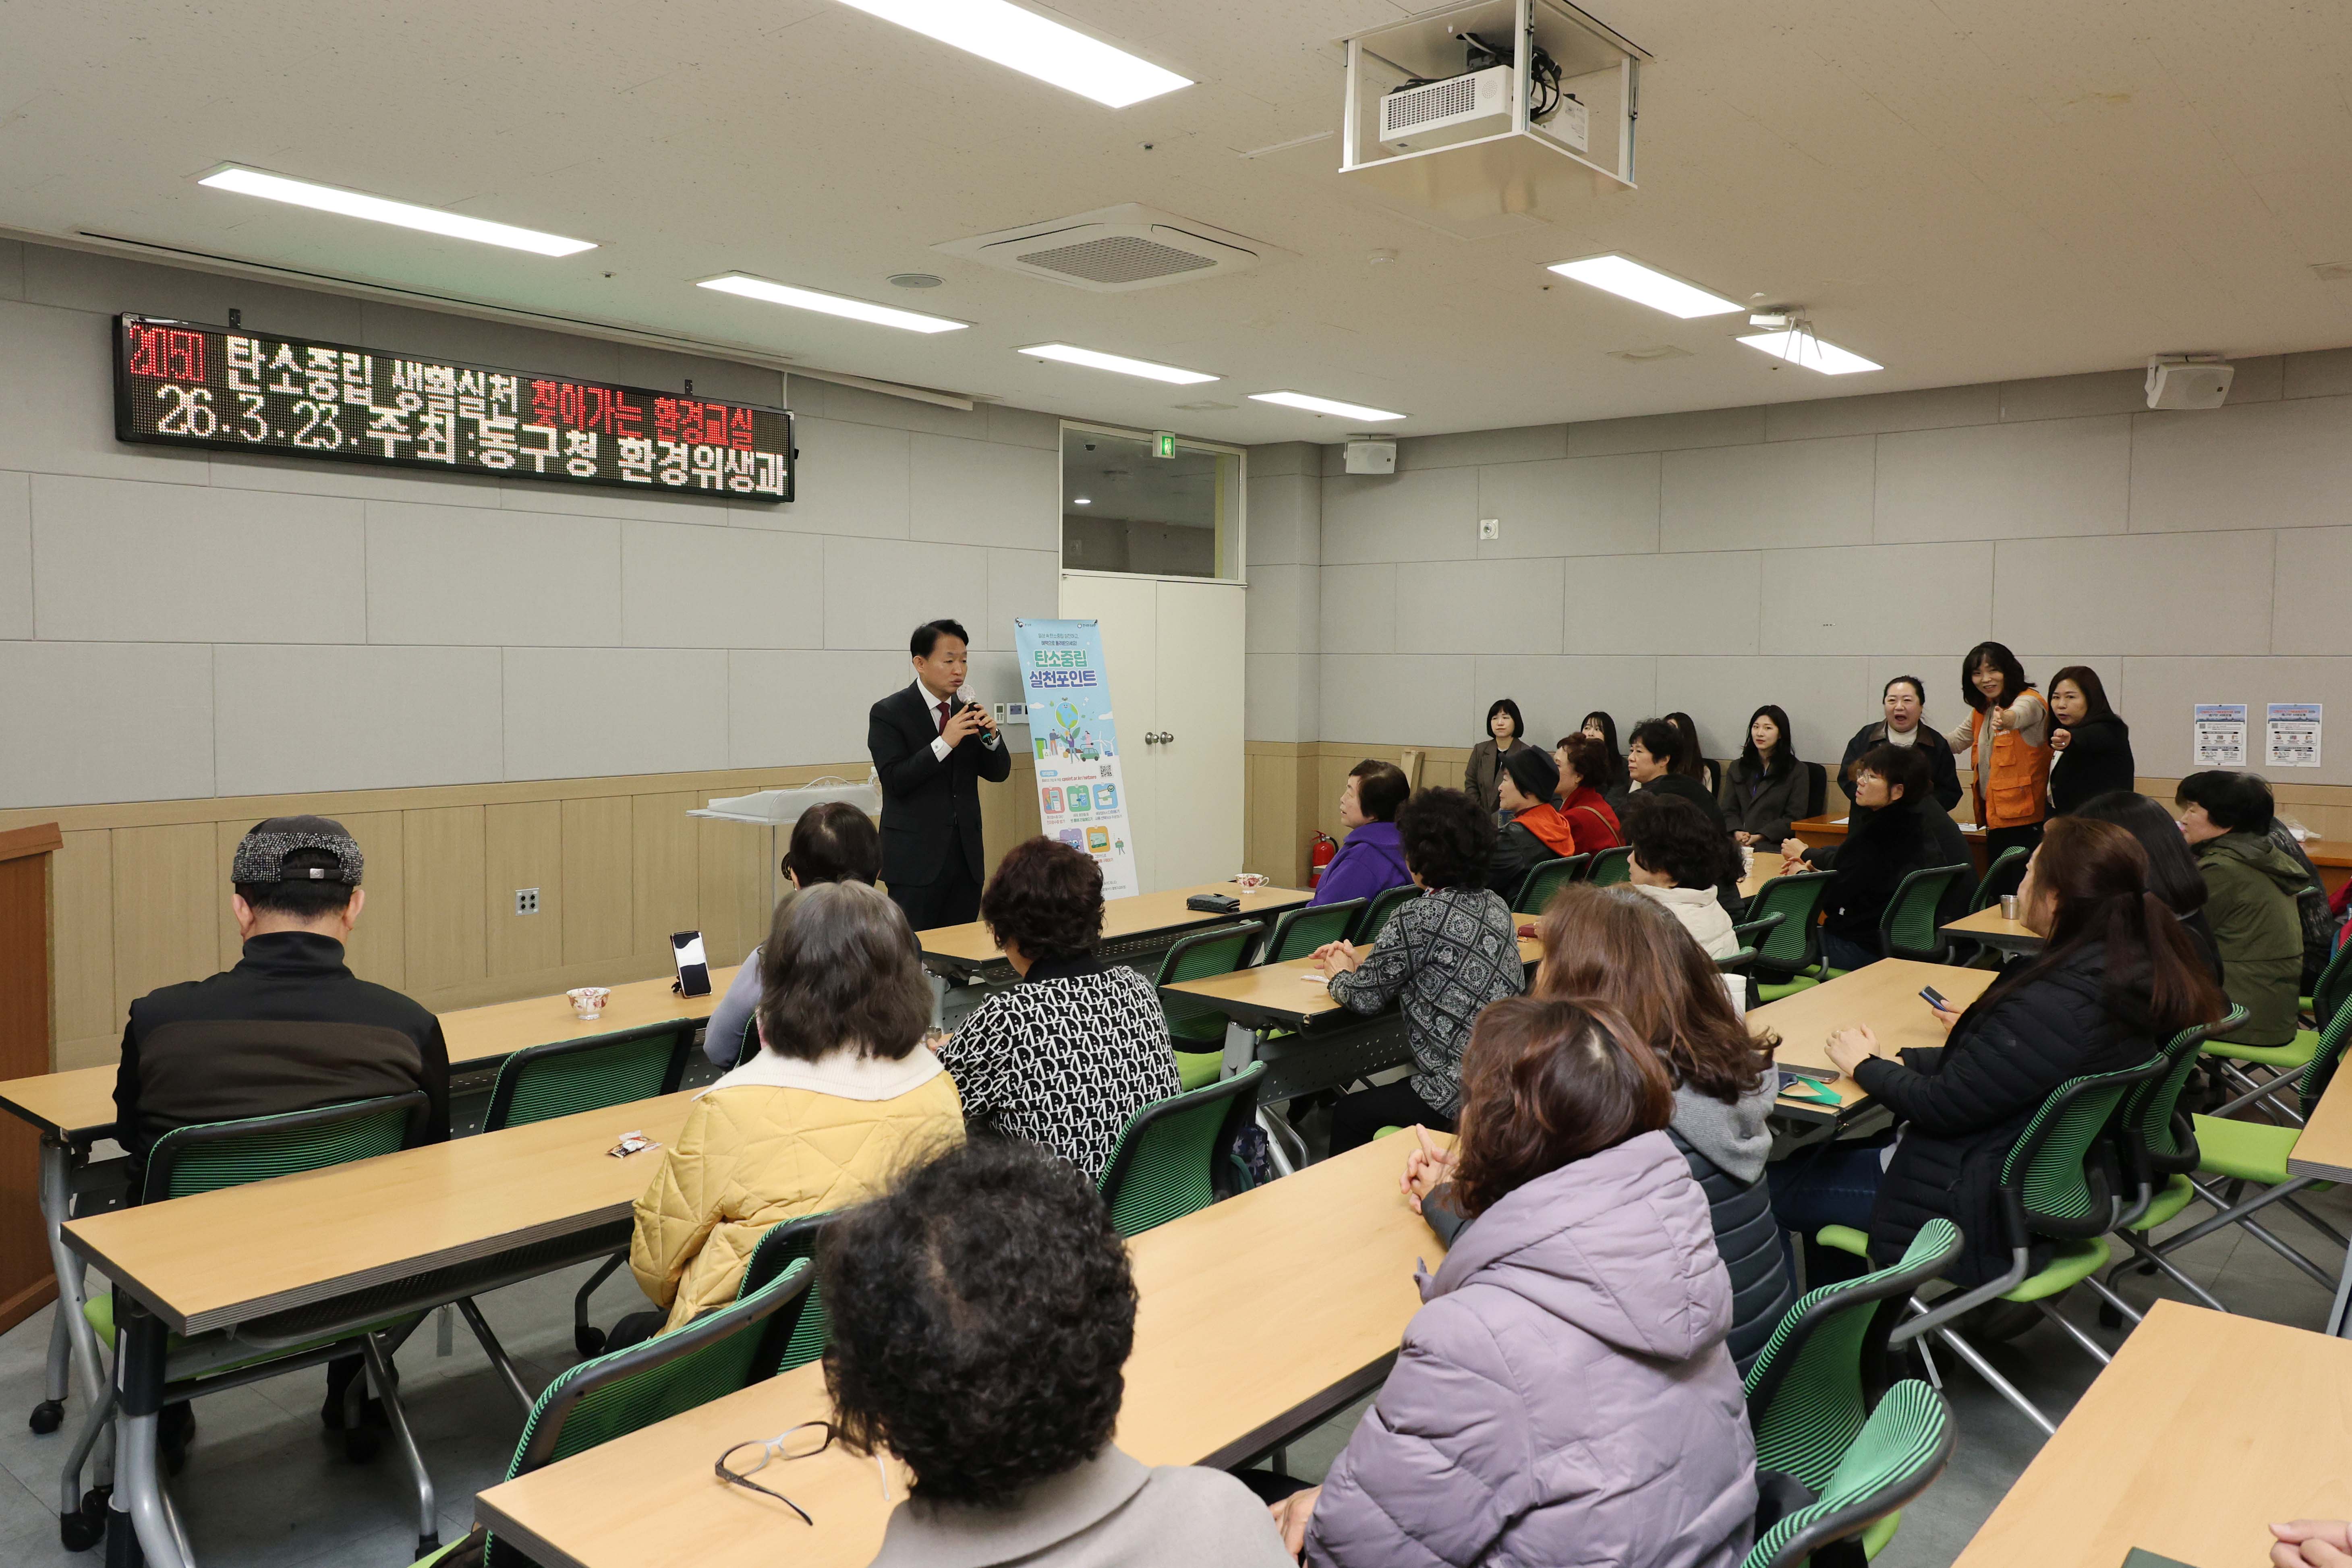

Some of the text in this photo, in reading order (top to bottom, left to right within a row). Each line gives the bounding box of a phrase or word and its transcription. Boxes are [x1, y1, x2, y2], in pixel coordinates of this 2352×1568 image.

[129, 325, 752, 452] 2050 탄소중립 생활실천 찾아가는 환경교실
[618, 437, 787, 496] 환경위생과
[1034, 650, 1088, 668] 탄소중립
[1029, 670, 1098, 688] 실천포인트
